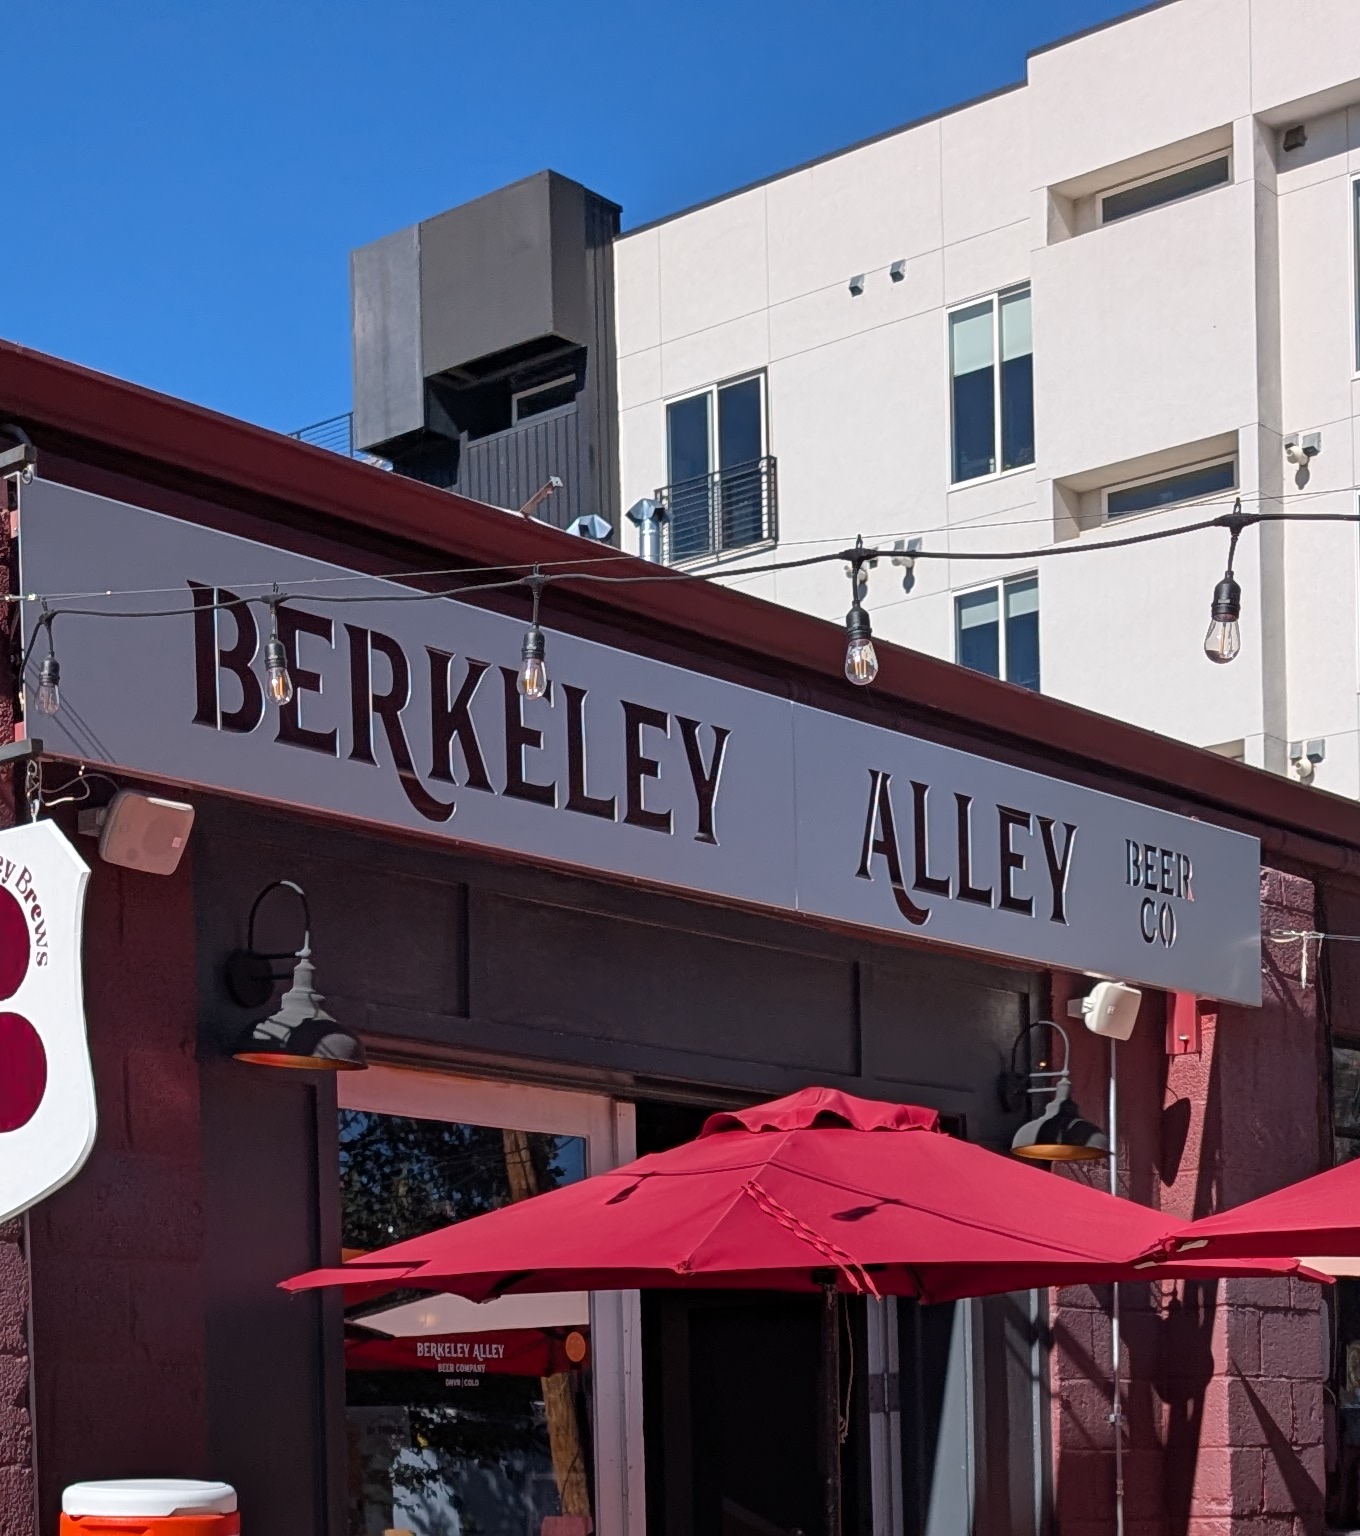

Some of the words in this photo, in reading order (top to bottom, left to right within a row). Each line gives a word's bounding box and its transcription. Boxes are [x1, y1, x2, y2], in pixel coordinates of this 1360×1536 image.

[187, 579, 732, 847] BERKELEY
[855, 769, 1078, 926] ALLEY
[1125, 838, 1195, 902] BEER
[15, 865, 49, 968] Brews
[1141, 897, 1177, 949] CO
[417, 1343, 470, 1360] BERKELEY
[473, 1344, 504, 1361] ALLEY
[438, 1364, 454, 1373] BEER
[456, 1364, 485, 1373] COMPANY
